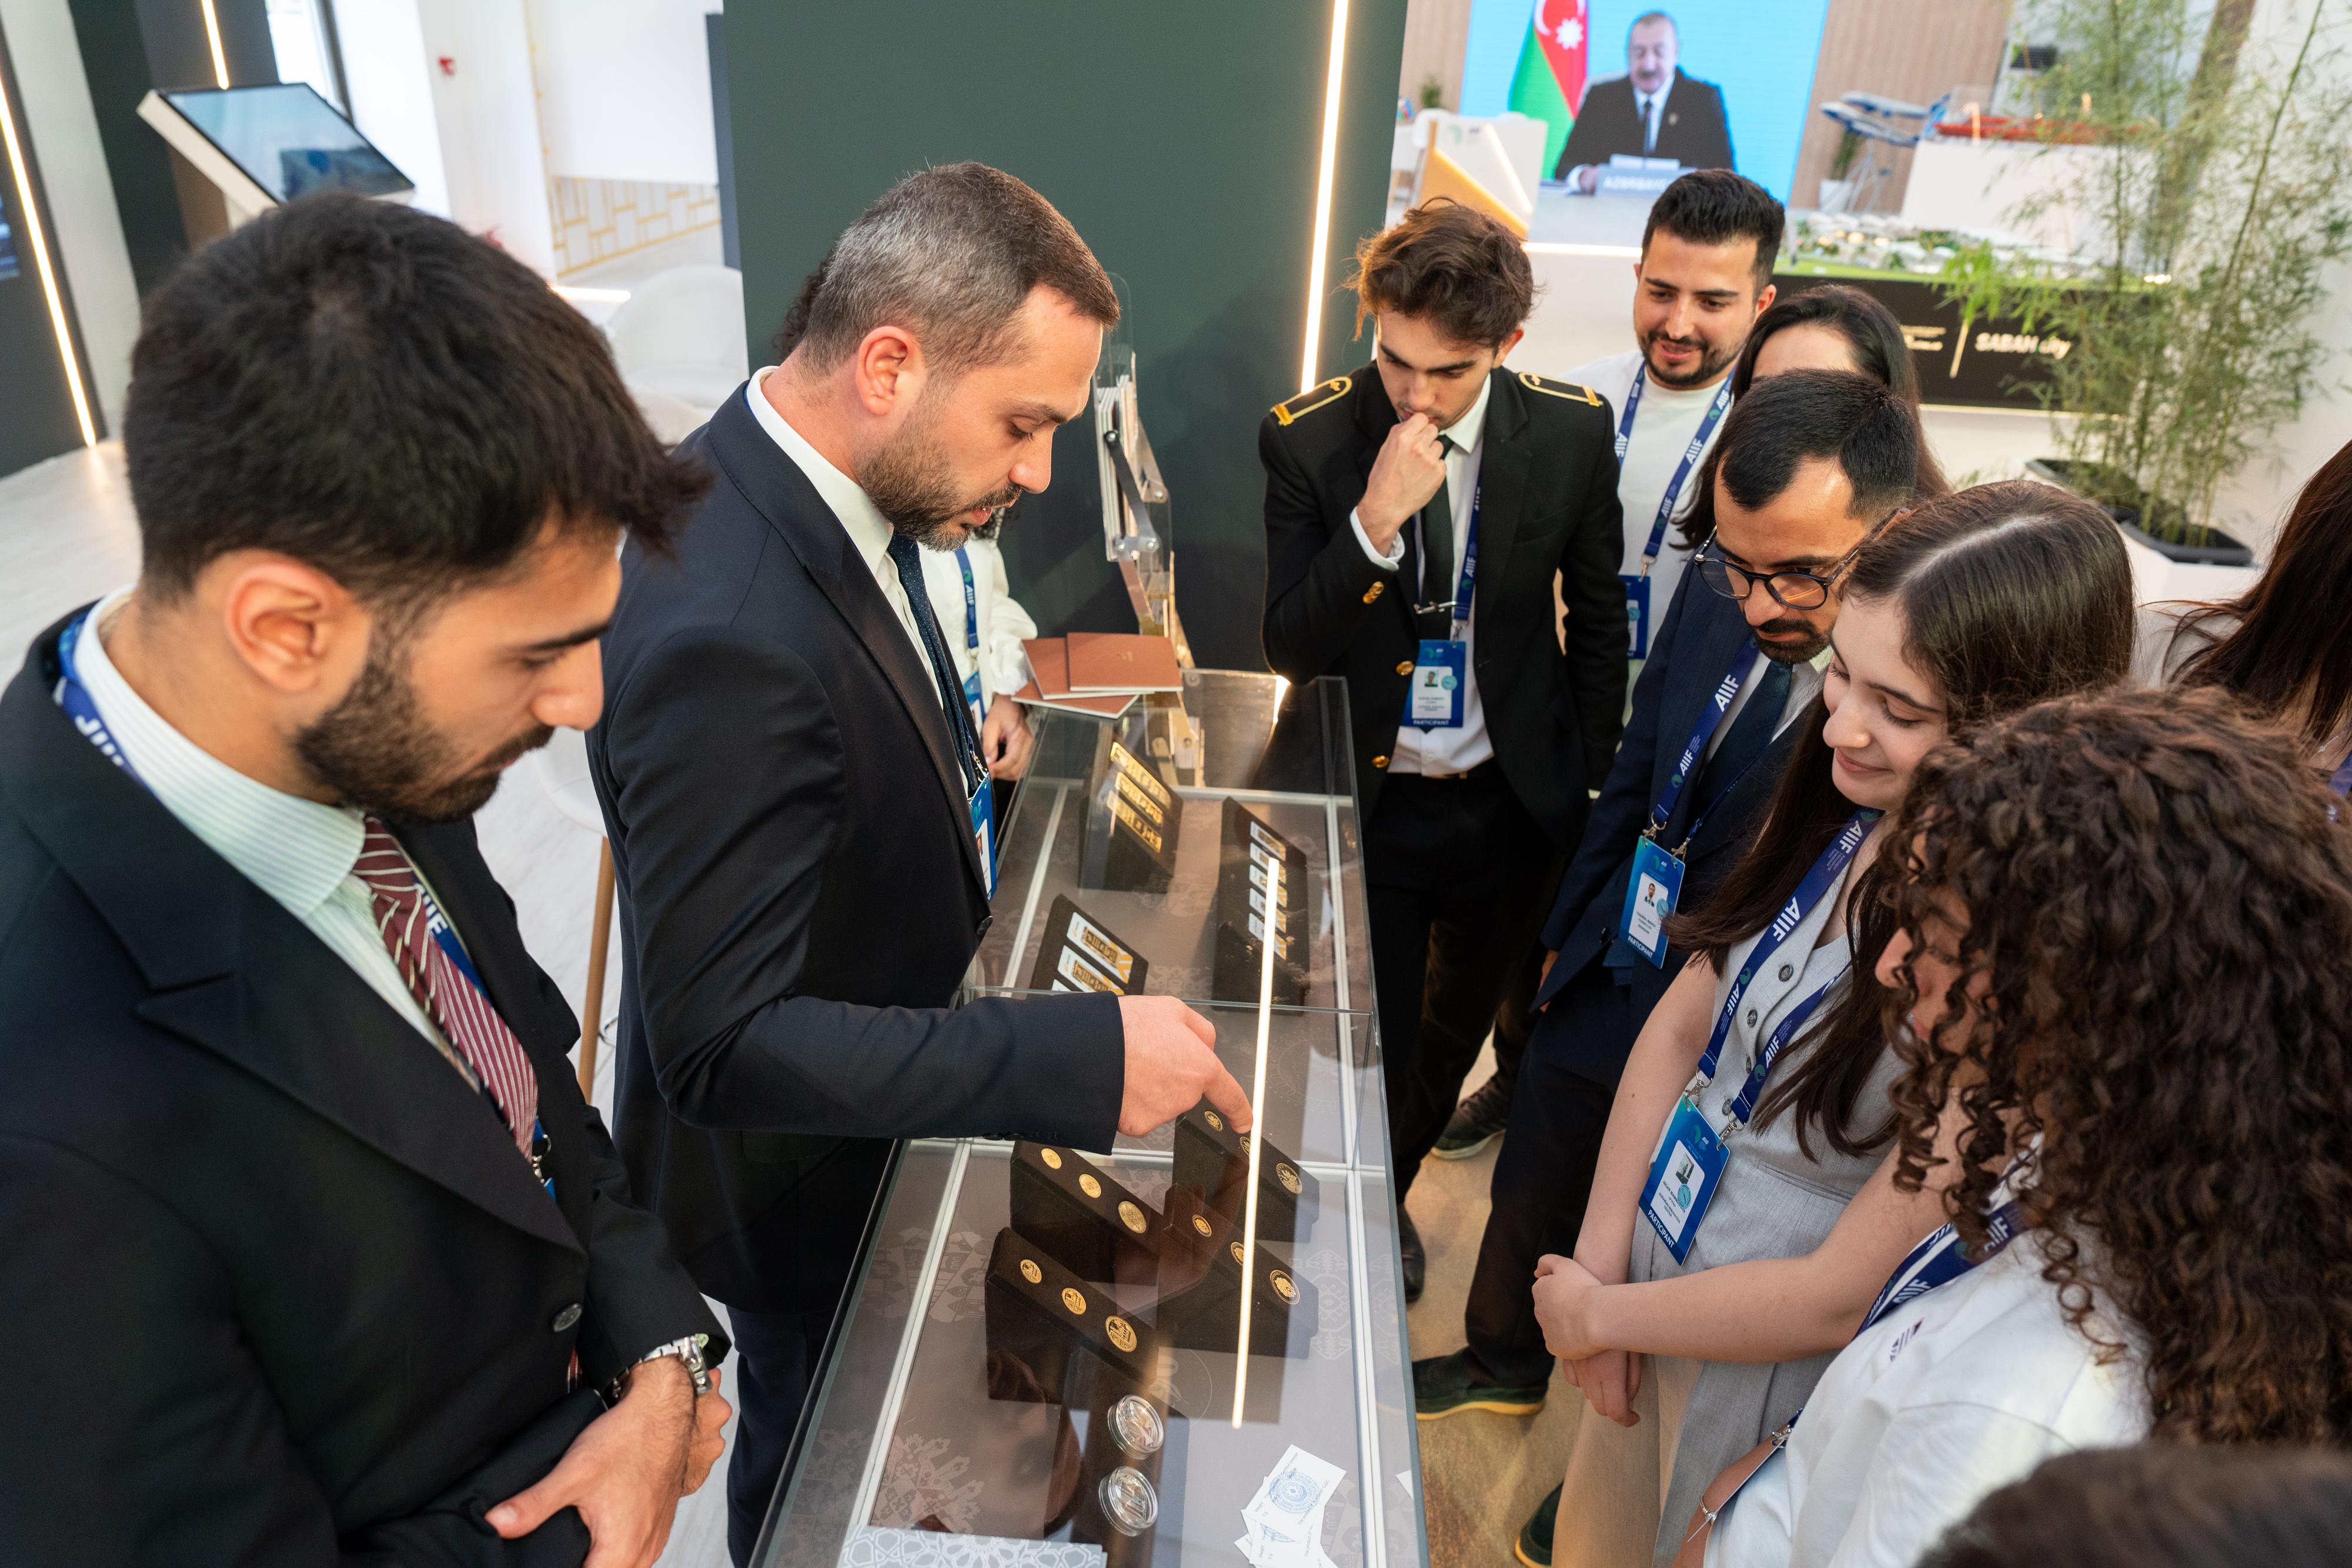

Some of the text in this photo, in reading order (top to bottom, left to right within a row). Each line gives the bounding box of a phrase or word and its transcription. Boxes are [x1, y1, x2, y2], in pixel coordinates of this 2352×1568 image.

[1716, 389, 1730, 410] AIIF
[1614, 432, 1628, 457] AIIF
[1685, 438, 1703, 464] AIIF
[1661, 497, 1674, 518] AIIF
[1465, 556, 1476, 578] AIIF
[965, 584, 974, 606] AIIF
[1715, 674, 1739, 713] AIIF
[1679, 749, 1693, 777] AIIF
[1839, 820, 1863, 854] AIIF
[1772, 897, 1800, 942] AIIF
[1628, 935, 1653, 958] PARTICIPANT
[1727, 983, 1739, 1016] AIIF
[1765, 1036, 1779, 1069] AIIF
[1648, 1209, 1675, 1248] PARTICIPANT
[1983, 1216, 2008, 1252] IIF
[1254, 1501, 1264, 1512] Weight
[1289, 1453, 1299, 1463] assayer
